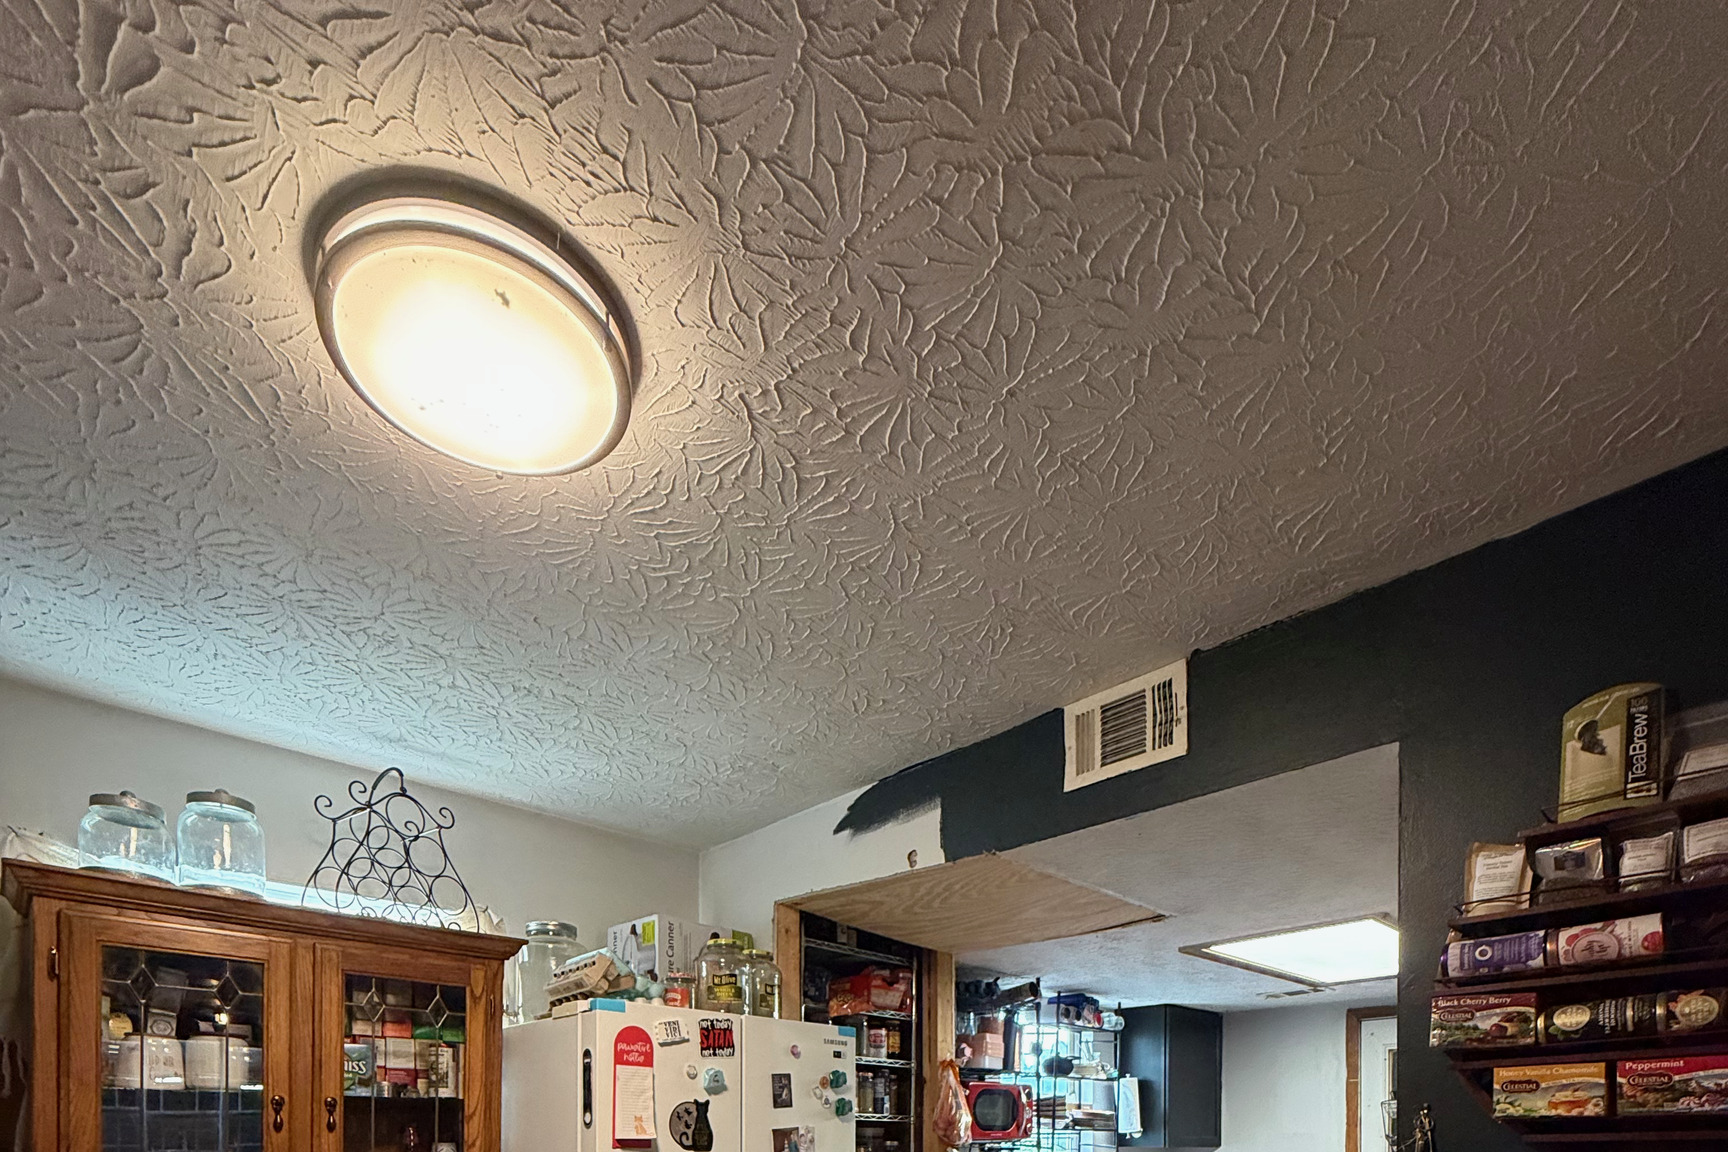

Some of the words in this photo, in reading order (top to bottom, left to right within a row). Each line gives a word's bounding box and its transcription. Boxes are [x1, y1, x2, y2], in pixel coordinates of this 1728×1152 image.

[1628, 713, 1649, 783] TeaBrew
[1460, 998, 1487, 1006] Cherry
[1488, 997, 1512, 1005] Berry
[700, 1029, 733, 1048] SATAN
[823, 1038, 848, 1047] SAMSUNG
[1625, 1060, 1685, 1071] Peppermint
[1628, 1075, 1671, 1085] CELESTIAL
[1502, 1082, 1538, 1092] CELESTIAL
